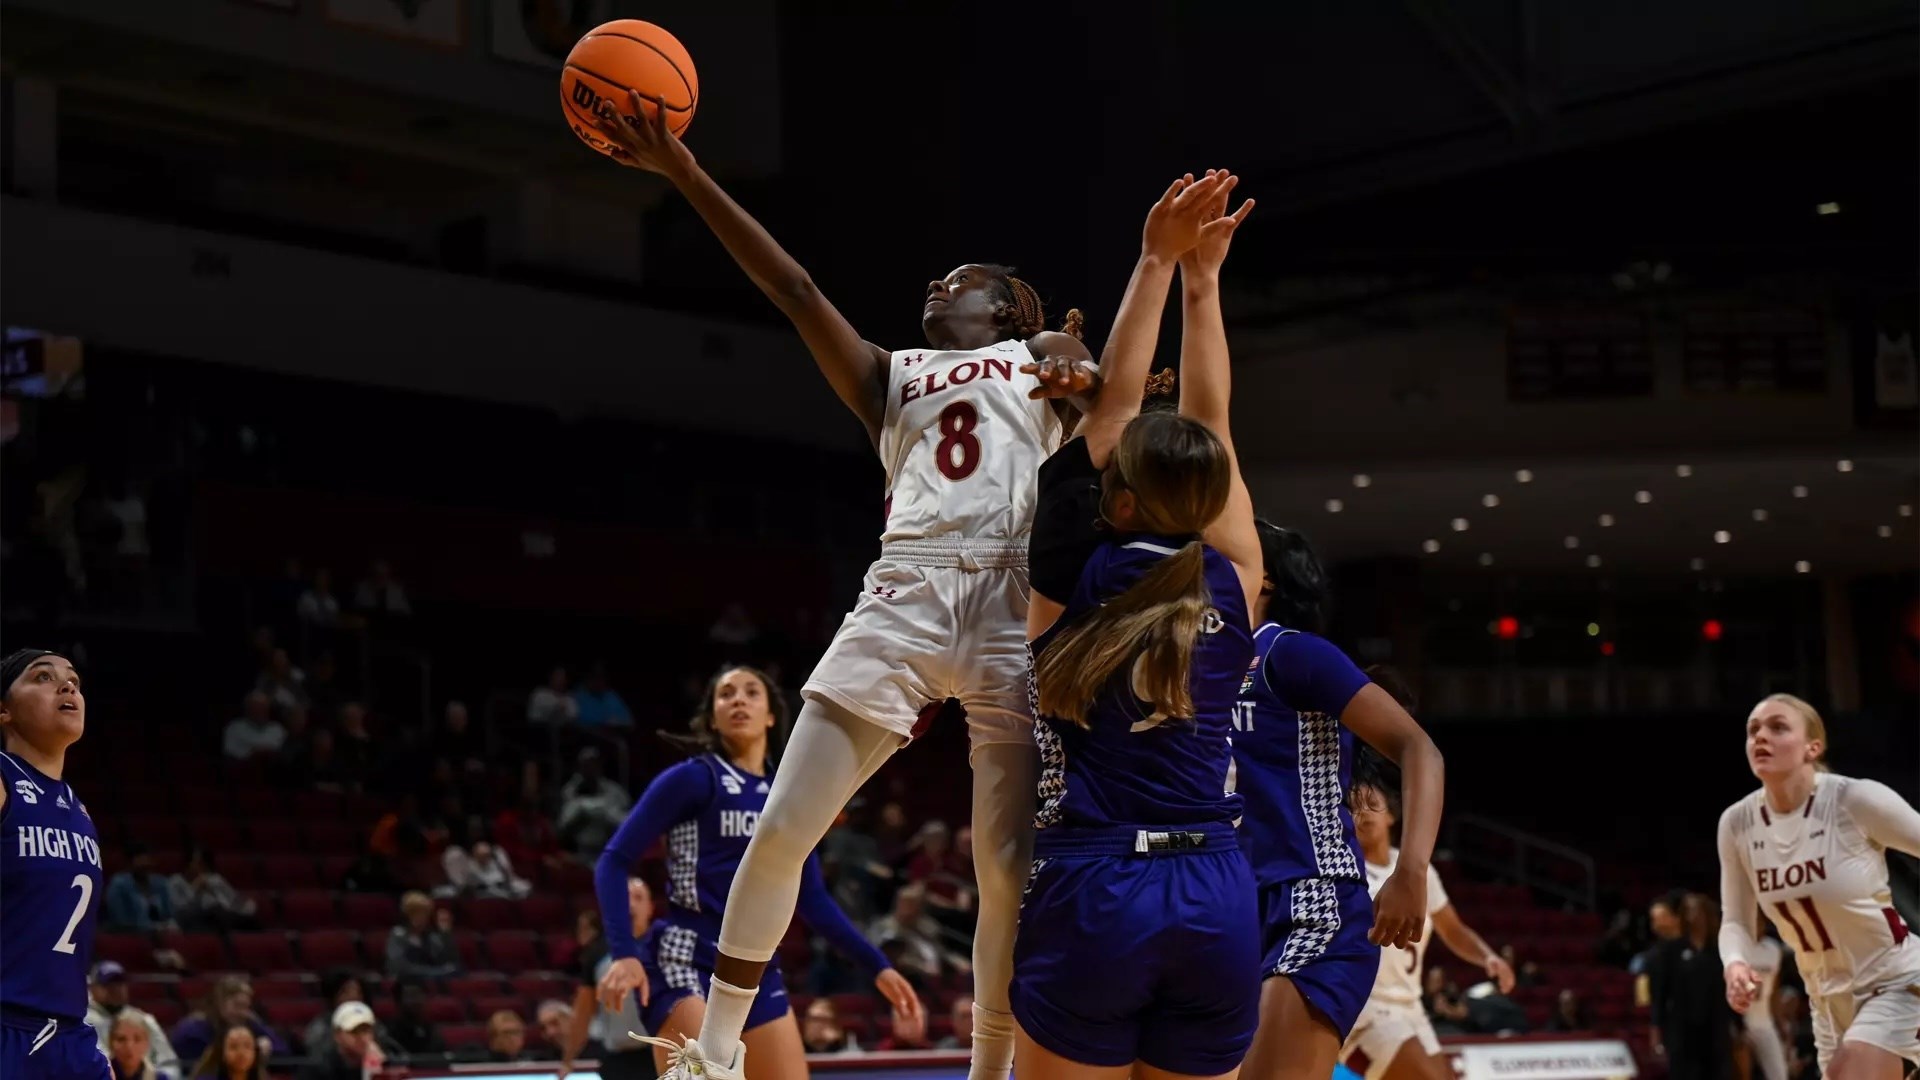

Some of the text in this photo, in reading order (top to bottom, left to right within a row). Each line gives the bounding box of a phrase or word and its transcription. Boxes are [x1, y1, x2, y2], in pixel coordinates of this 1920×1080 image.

[899, 358, 1014, 409] ELON
[934, 399, 982, 482] 8
[17, 825, 73, 860] HIGH
[1756, 857, 1827, 893] ELON
[51, 873, 93, 955] 2
[1773, 896, 1834, 952] 11
